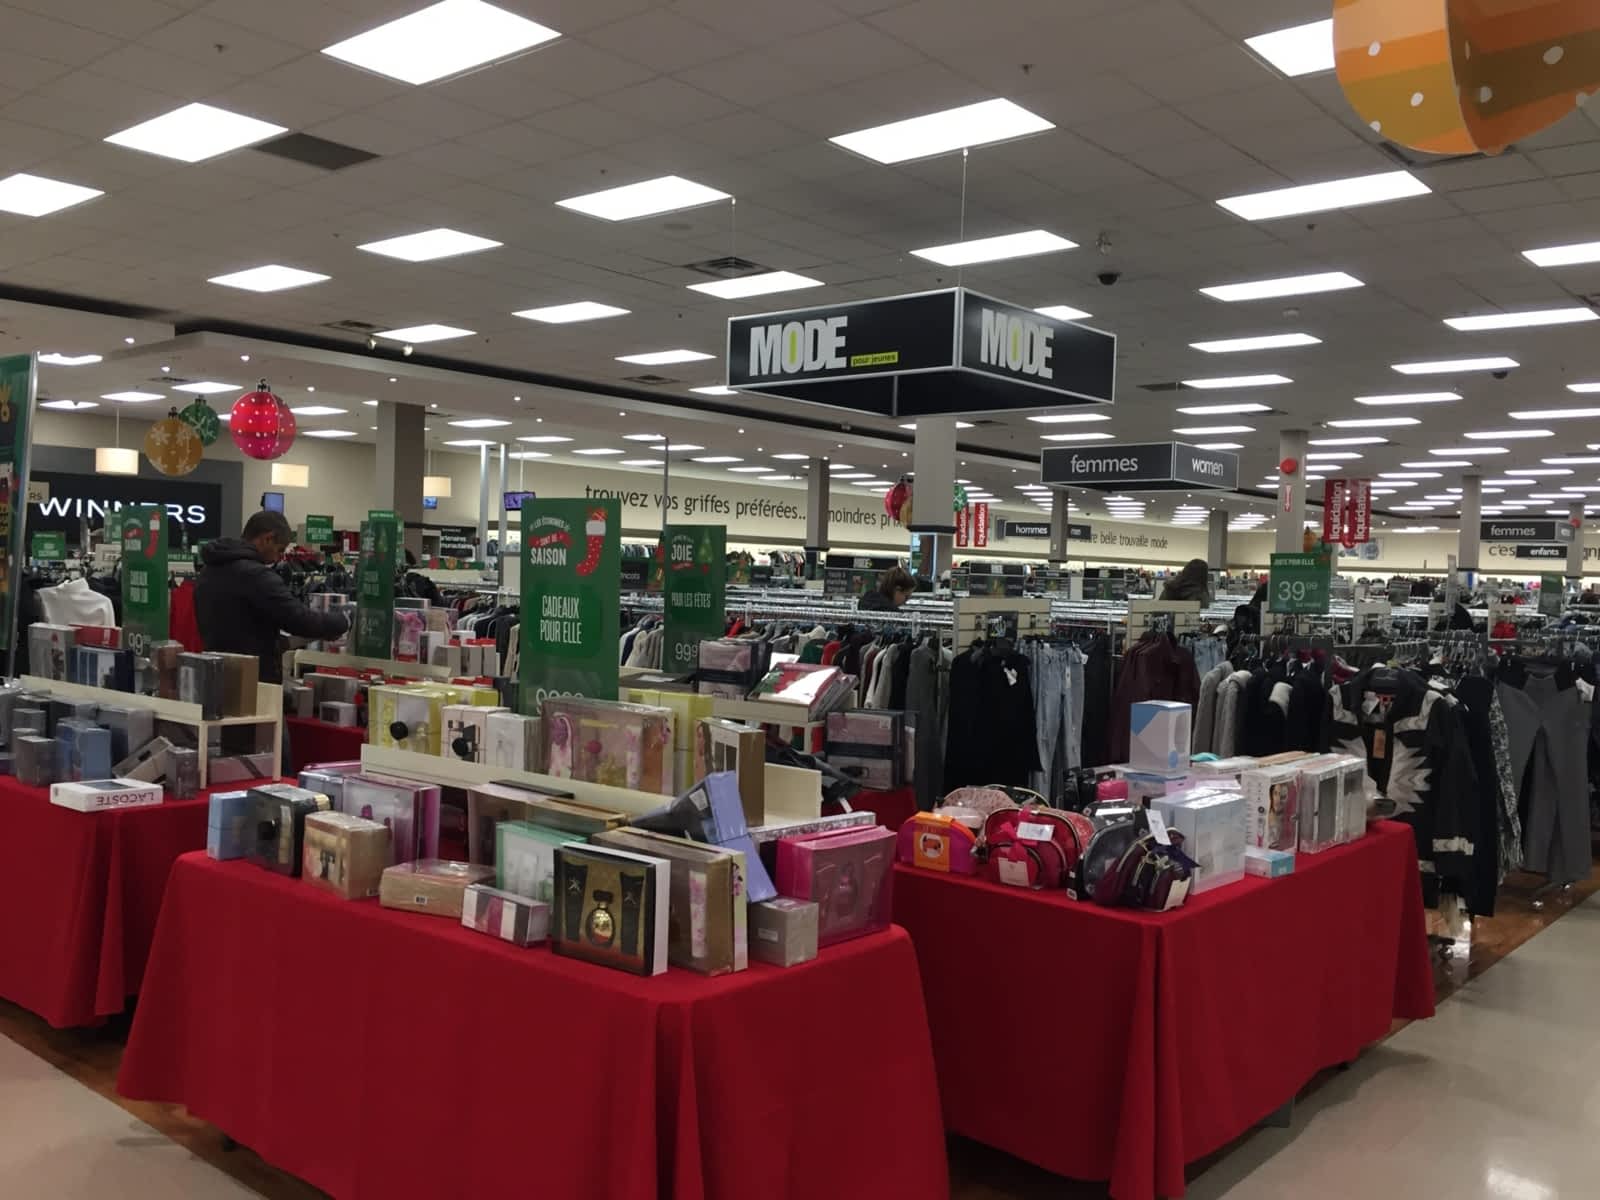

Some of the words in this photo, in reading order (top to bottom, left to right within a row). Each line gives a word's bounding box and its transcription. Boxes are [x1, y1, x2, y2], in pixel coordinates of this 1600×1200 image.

[750, 315, 848, 377] MODE
[980, 307, 1054, 379] MODE
[852, 357, 870, 366] pour
[871, 353, 896, 364] jeunes
[1070, 454, 1138, 473] femmes
[1192, 457, 1223, 476] women
[585, 484, 648, 508] trouvez
[654, 494, 678, 510] vos
[684, 494, 730, 515] griffes
[39, 496, 206, 524] WINRS
[1329, 482, 1343, 540] liquidation
[1015, 524, 1048, 535] hommes
[1490, 524, 1536, 537] femmes
[671, 543, 694, 561] JOIE
[1151, 536, 1169, 549] mode
[1488, 543, 1516, 557] c'es
[1530, 547, 1560, 556] enfants
[530, 547, 568, 567] SAISON
[542, 594, 580, 619] CADEAUX
[540, 619, 561, 642] POUR
[562, 621, 583, 645] ELLE
[95, 791, 155, 807] LACOSTE
